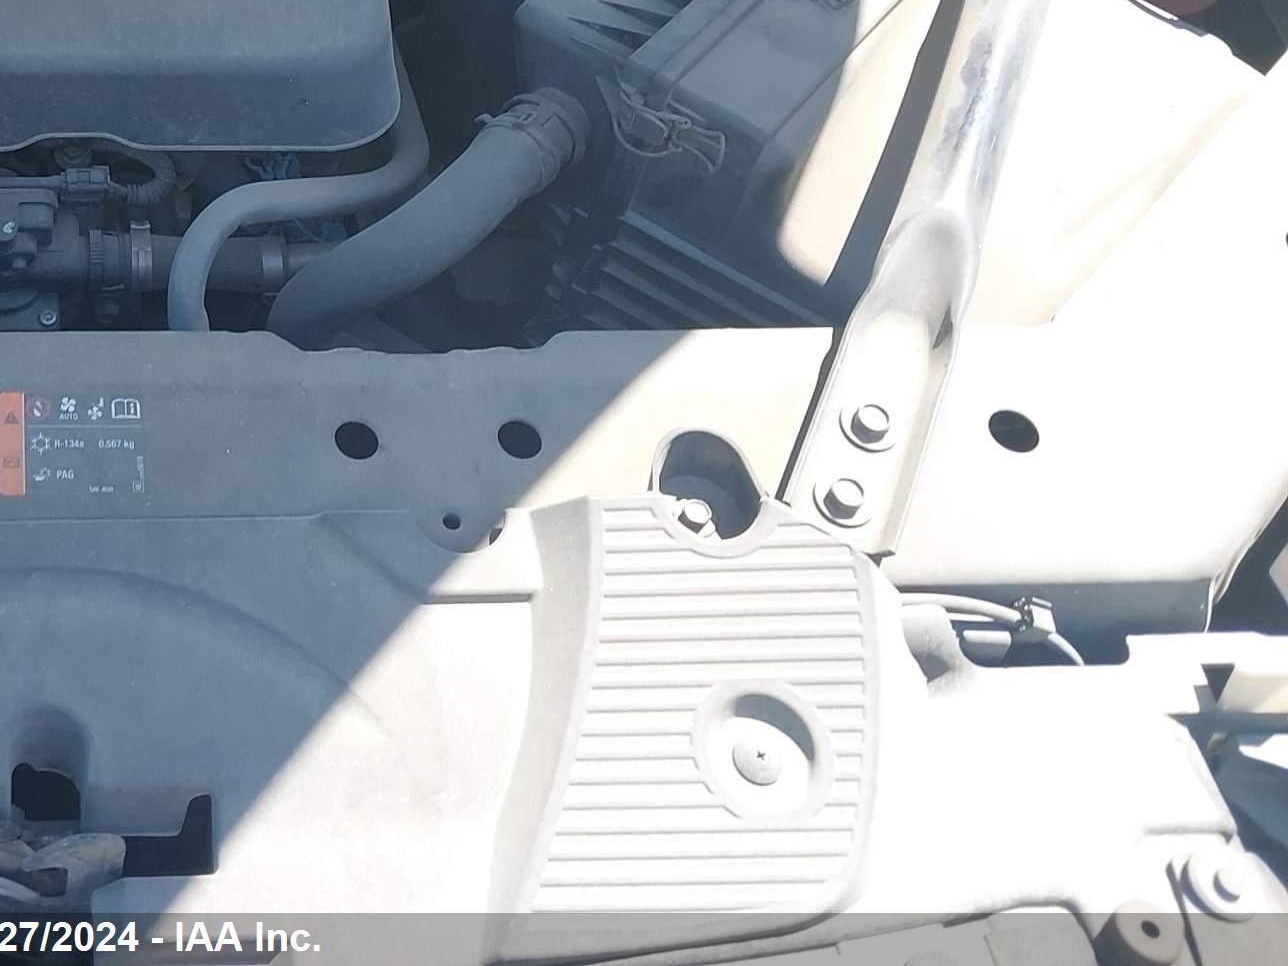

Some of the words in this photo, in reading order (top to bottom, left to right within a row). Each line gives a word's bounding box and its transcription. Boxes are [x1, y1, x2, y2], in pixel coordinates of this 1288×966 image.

[59, 413, 79, 421] AUTO
[54, 438, 85, 449] R-134a
[123, 438, 136, 451] kg
[56, 468, 75, 480] PAG
